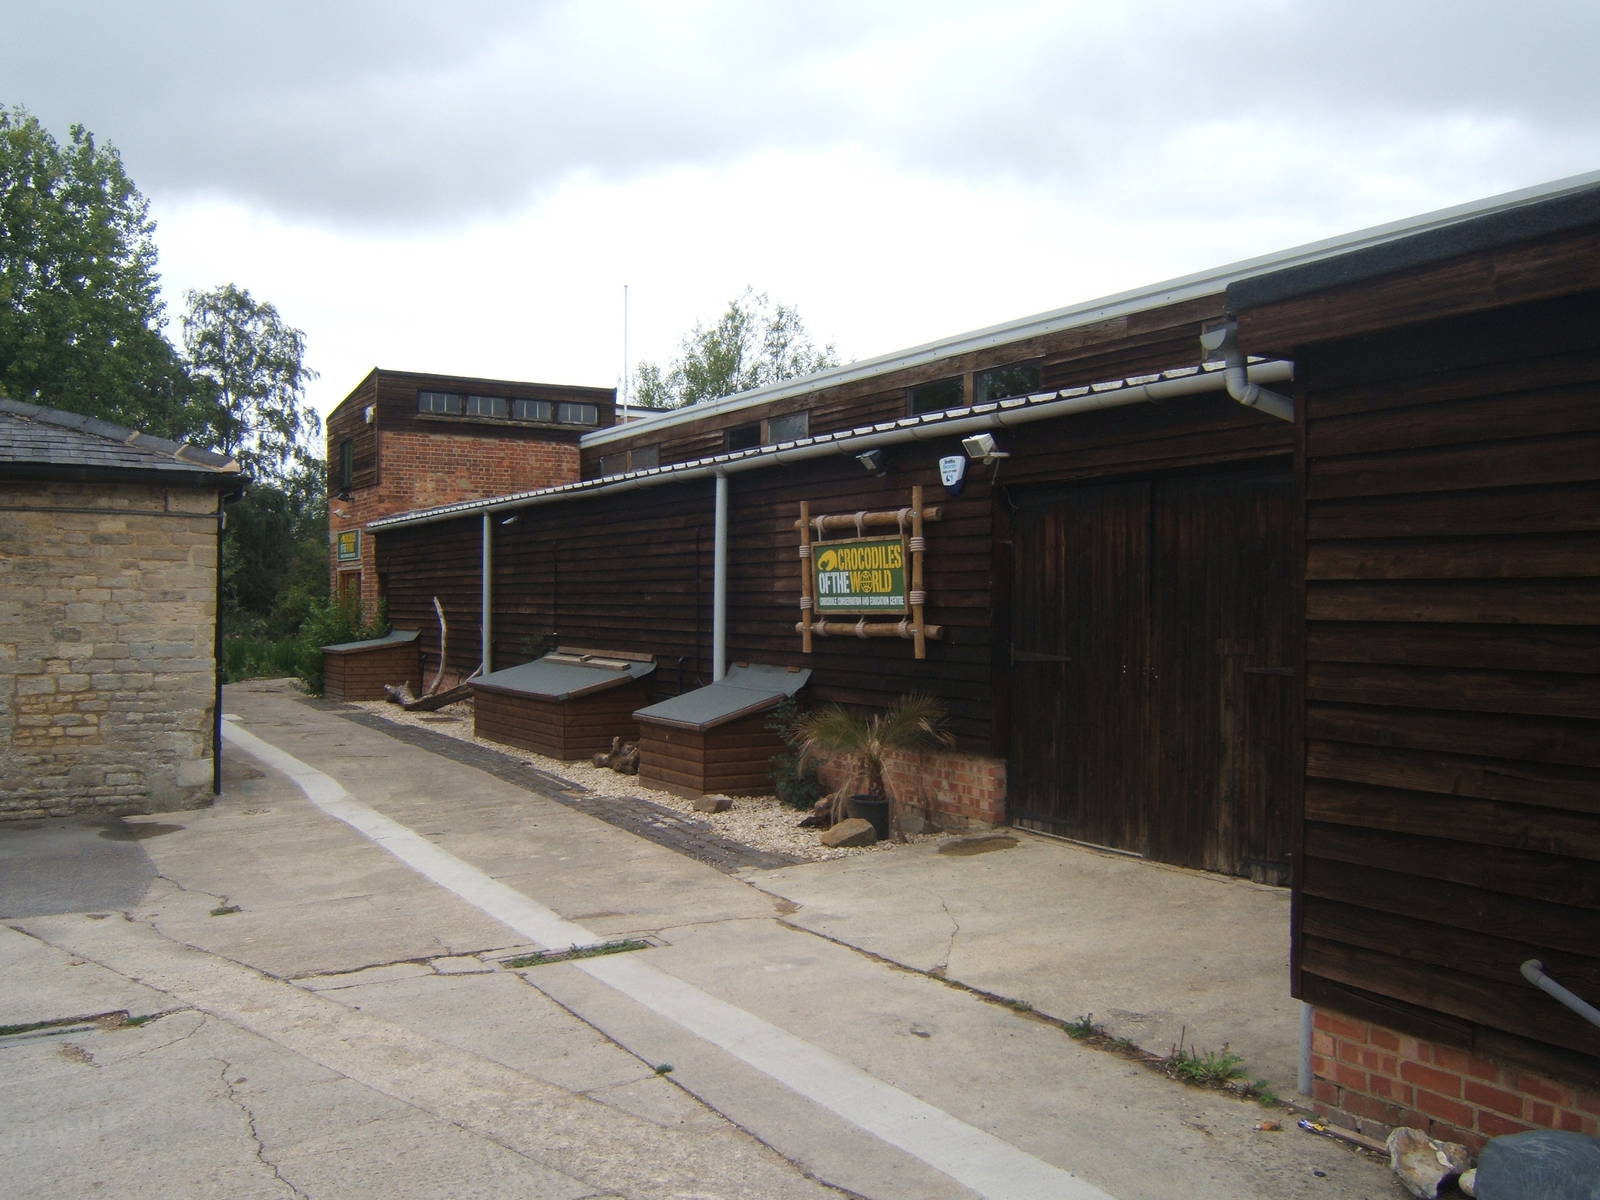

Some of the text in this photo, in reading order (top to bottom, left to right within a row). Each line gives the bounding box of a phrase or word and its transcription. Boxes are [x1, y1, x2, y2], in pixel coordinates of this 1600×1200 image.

[838, 545, 902, 570] CROCODILES
[819, 570, 892, 594] OF THE WORLD
